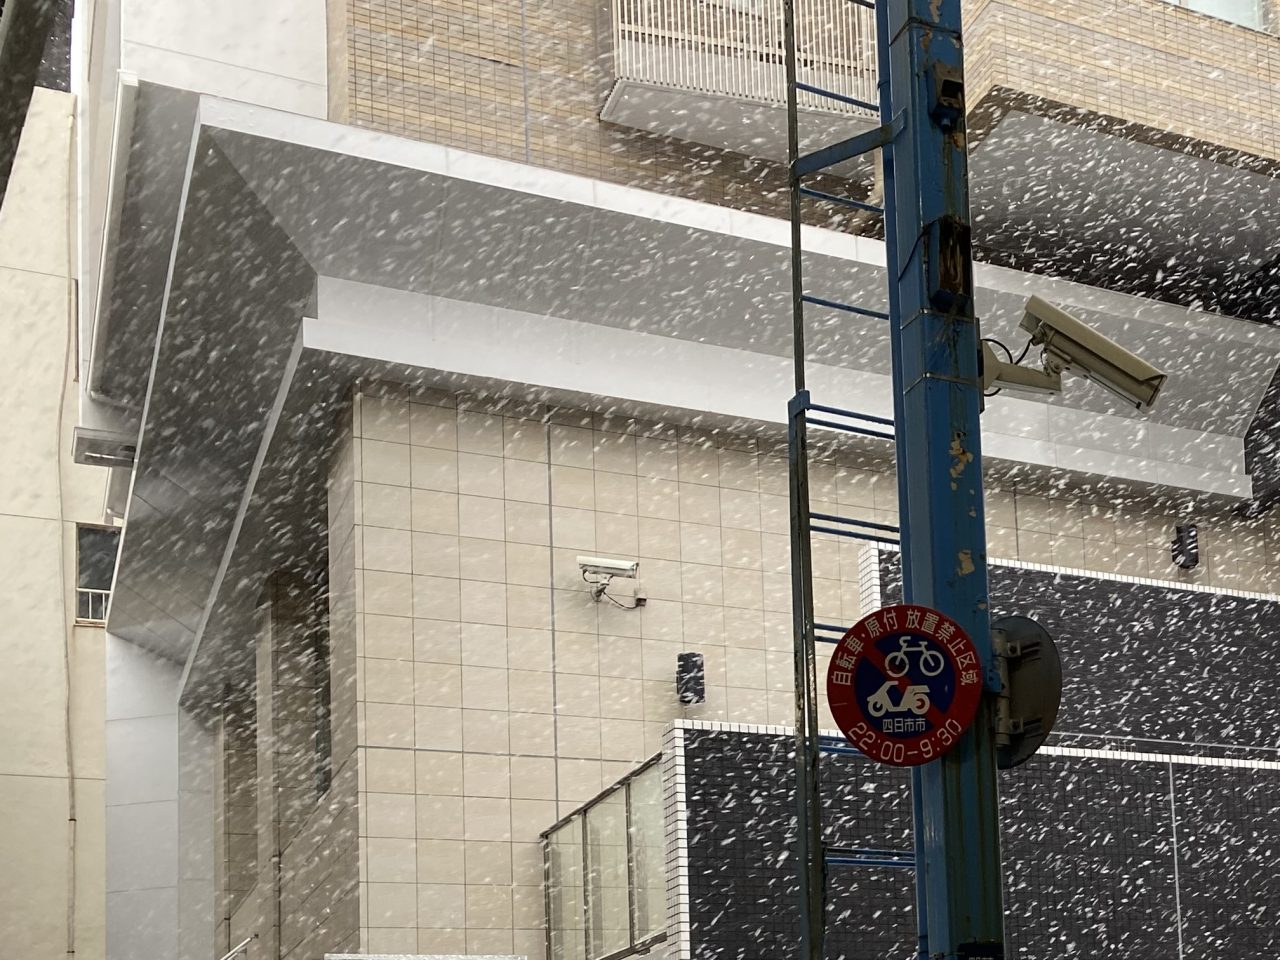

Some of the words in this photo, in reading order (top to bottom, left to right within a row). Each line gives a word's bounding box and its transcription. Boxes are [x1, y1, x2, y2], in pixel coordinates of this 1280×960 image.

[905, 608, 978, 686] 放置禁止区域
[882, 718, 926, 733] 四日市市
